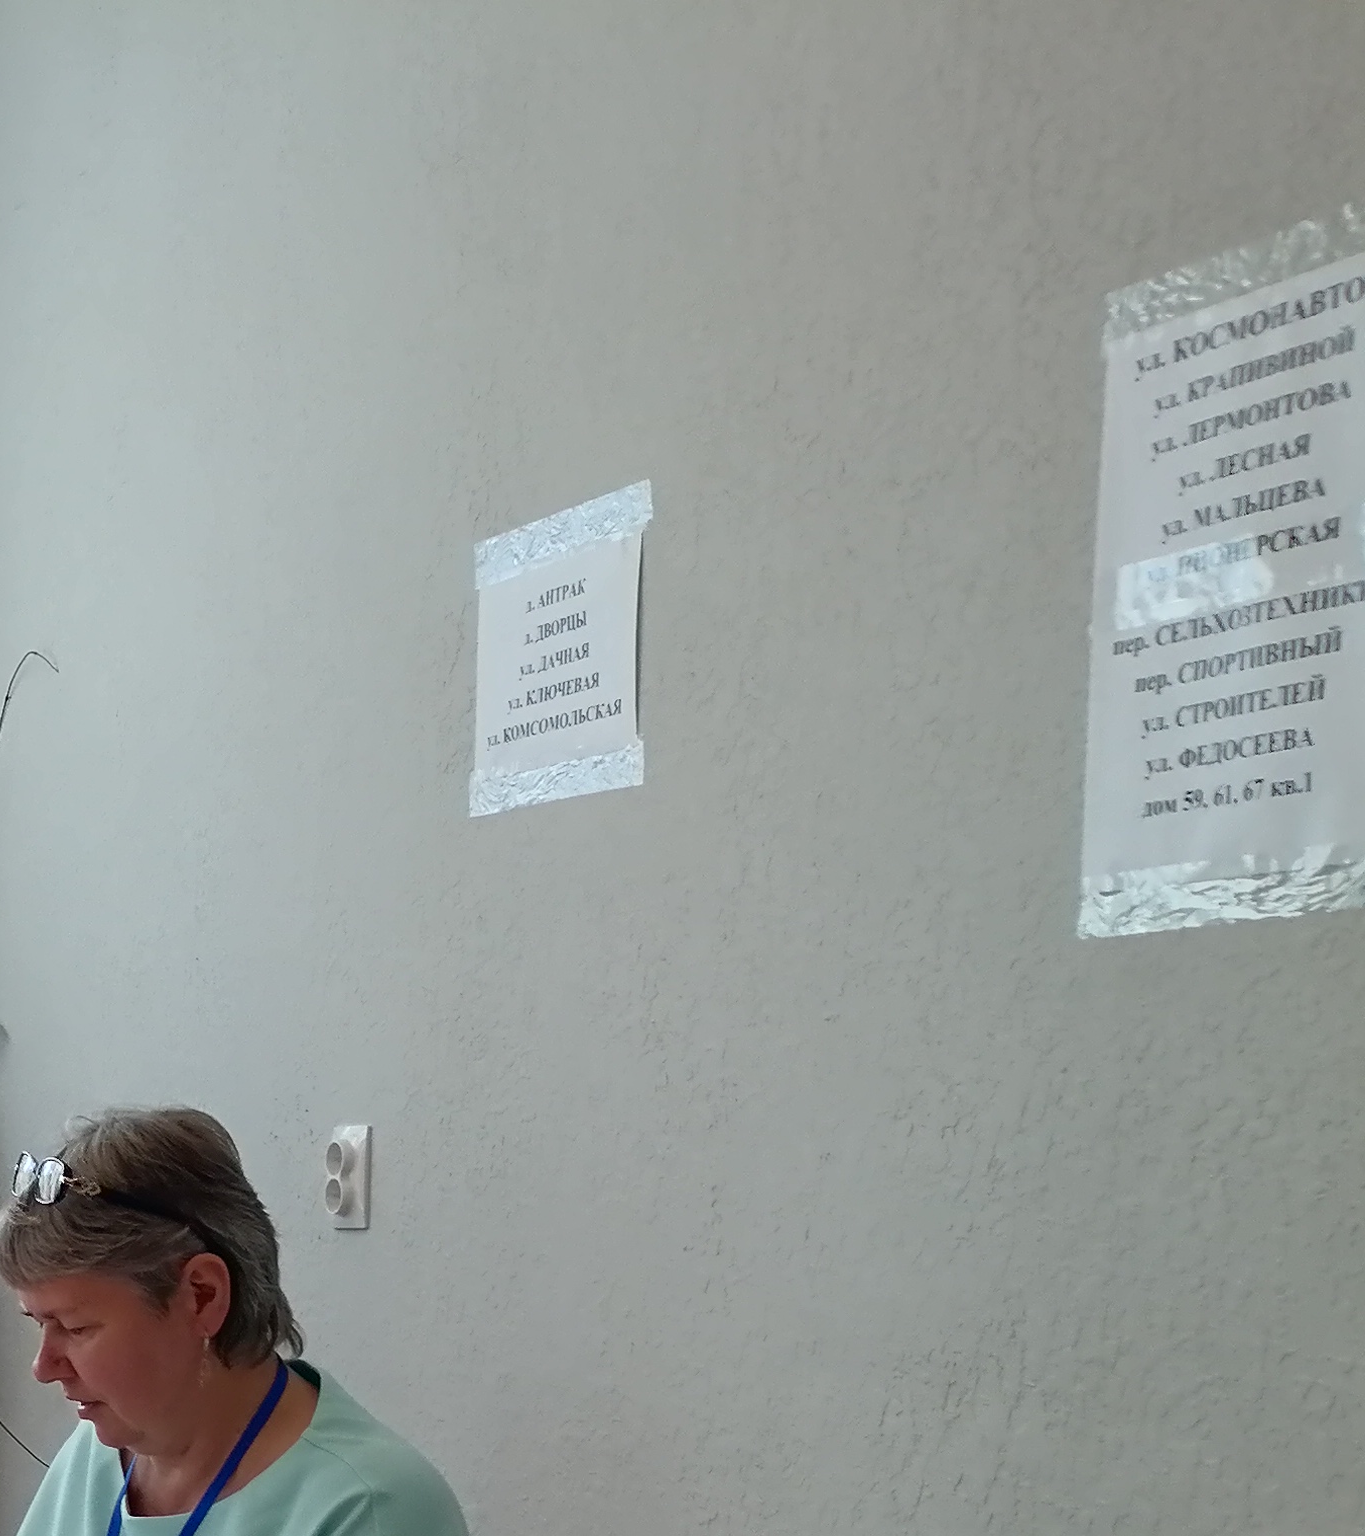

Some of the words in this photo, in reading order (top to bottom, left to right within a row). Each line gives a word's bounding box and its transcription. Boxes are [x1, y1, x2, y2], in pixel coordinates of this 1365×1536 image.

[1182, 380, 1352, 446] ЛЕРМОНТОВА
[1208, 433, 1312, 482] ЛЕСНАЯ
[1193, 478, 1326, 527] МАЛЬЦЕВА
[537, 577, 587, 609] АНТРАК
[535, 610, 588, 643] ДВОРЦЫ
[1112, 636, 1150, 657] пер.
[537, 641, 590, 674] ДАЧНАЯ
[1134, 674, 1172, 695] пер.
[1177, 626, 1343, 684] СПОРТИВНЫЙ
[526, 671, 600, 706] КЛЮЧЕВАЯ
[1175, 674, 1327, 727] СТРОИТЕЛЕЙ
[503, 698, 622, 744] КОМСОМОЛЬСКАЯ
[1177, 727, 1316, 768] ФЕДОСЕЕВА
[1140, 799, 1178, 818] дом
